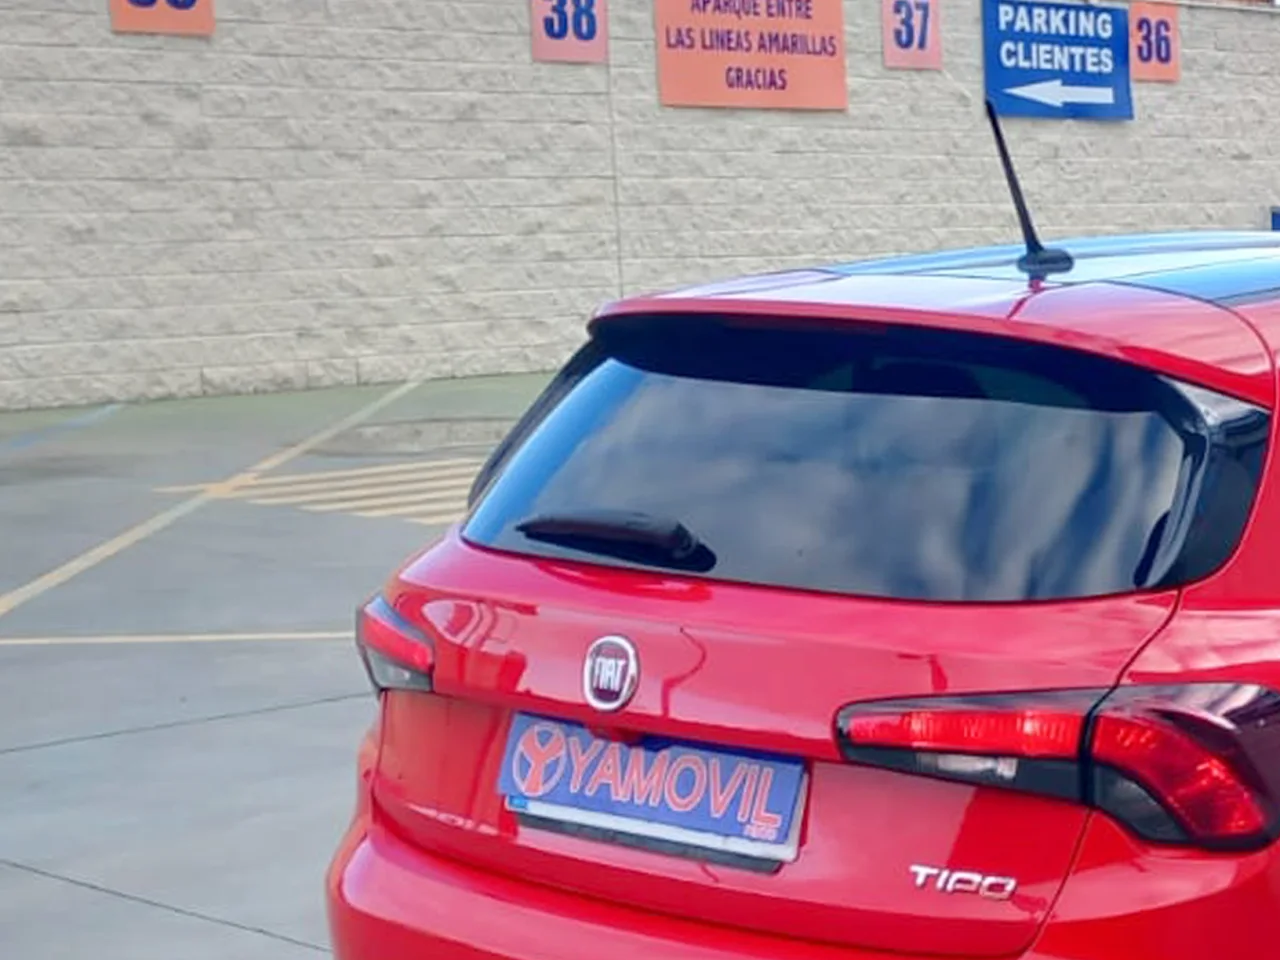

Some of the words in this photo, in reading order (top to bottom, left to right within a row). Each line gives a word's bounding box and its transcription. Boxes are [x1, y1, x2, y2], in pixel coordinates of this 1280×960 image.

[543, 0, 597, 41] 38
[766, 0, 813, 19] ENTRE
[893, 0, 930, 51] 37
[998, 4, 1113, 39] PARKING
[665, 26, 695, 49] LAS
[701, 29, 752, 52] LINEAS
[758, 32, 837, 57] AMARILLAS
[1000, 41, 1114, 74] CLIENTES
[1137, 17, 1172, 64] 36
[725, 66, 787, 91] GRACIAS
[593, 657, 626, 692] FIAT
[568, 736, 782, 828] YAMOVIL
[909, 864, 1017, 899] TIPO
